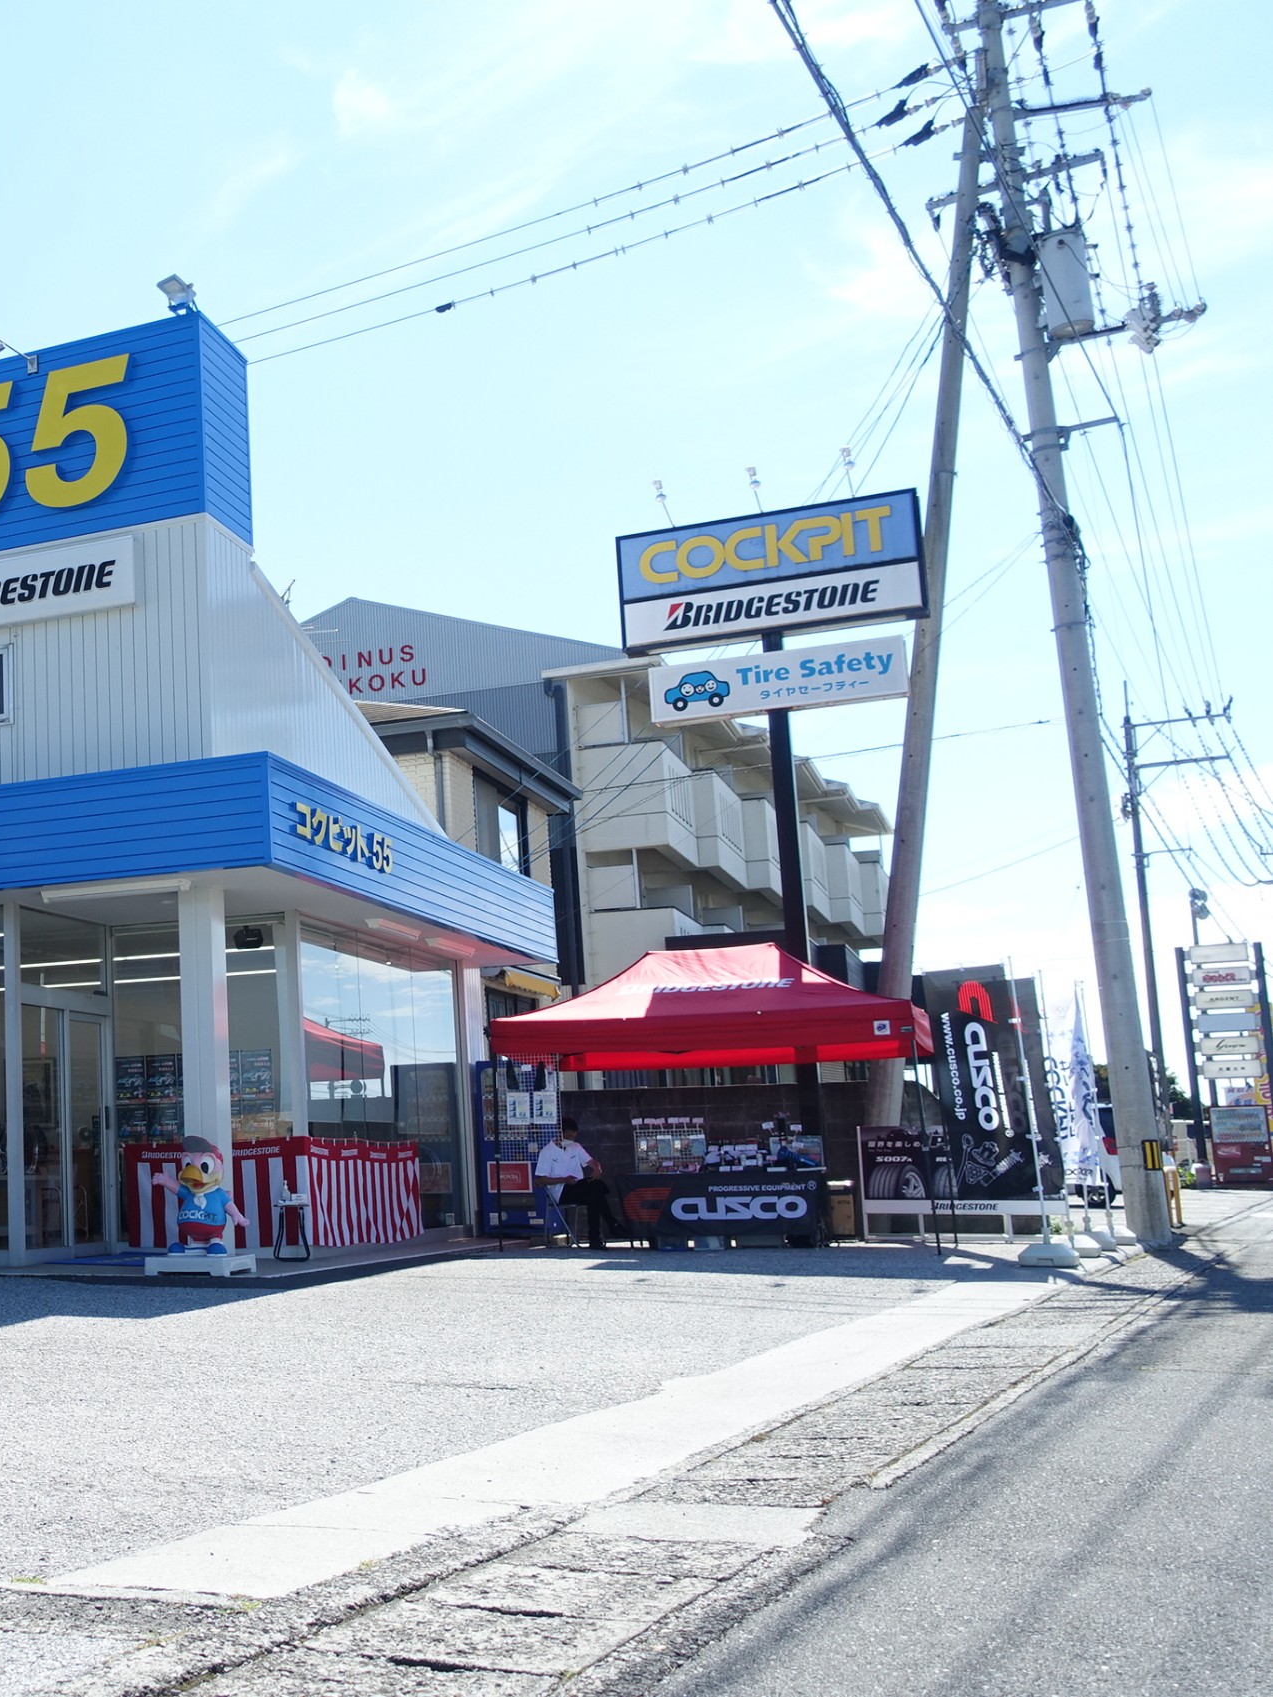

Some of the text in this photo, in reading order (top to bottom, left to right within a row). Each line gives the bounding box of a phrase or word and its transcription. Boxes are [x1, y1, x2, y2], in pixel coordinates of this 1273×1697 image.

[639, 504, 891, 584] COCKPIT
[663, 579, 880, 631] BRIDGESTONE
[339, 668, 426, 695] KOKU
[736, 651, 894, 686] Tire Safety
[759, 680, 869, 700] タイヤセーフティー
[295, 801, 393, 874] コクピット 55
[940, 1012, 967, 1121] www.cusco.co.jp
[964, 1021, 1000, 1132] CUSCO
[141, 1150, 182, 1160] BRIDGESTO
[876, 1155, 913, 1163] S007A
[708, 1183, 806, 1193] PROGRESSIVE EQUIPMENT
[671, 1195, 808, 1221] CUSCO
